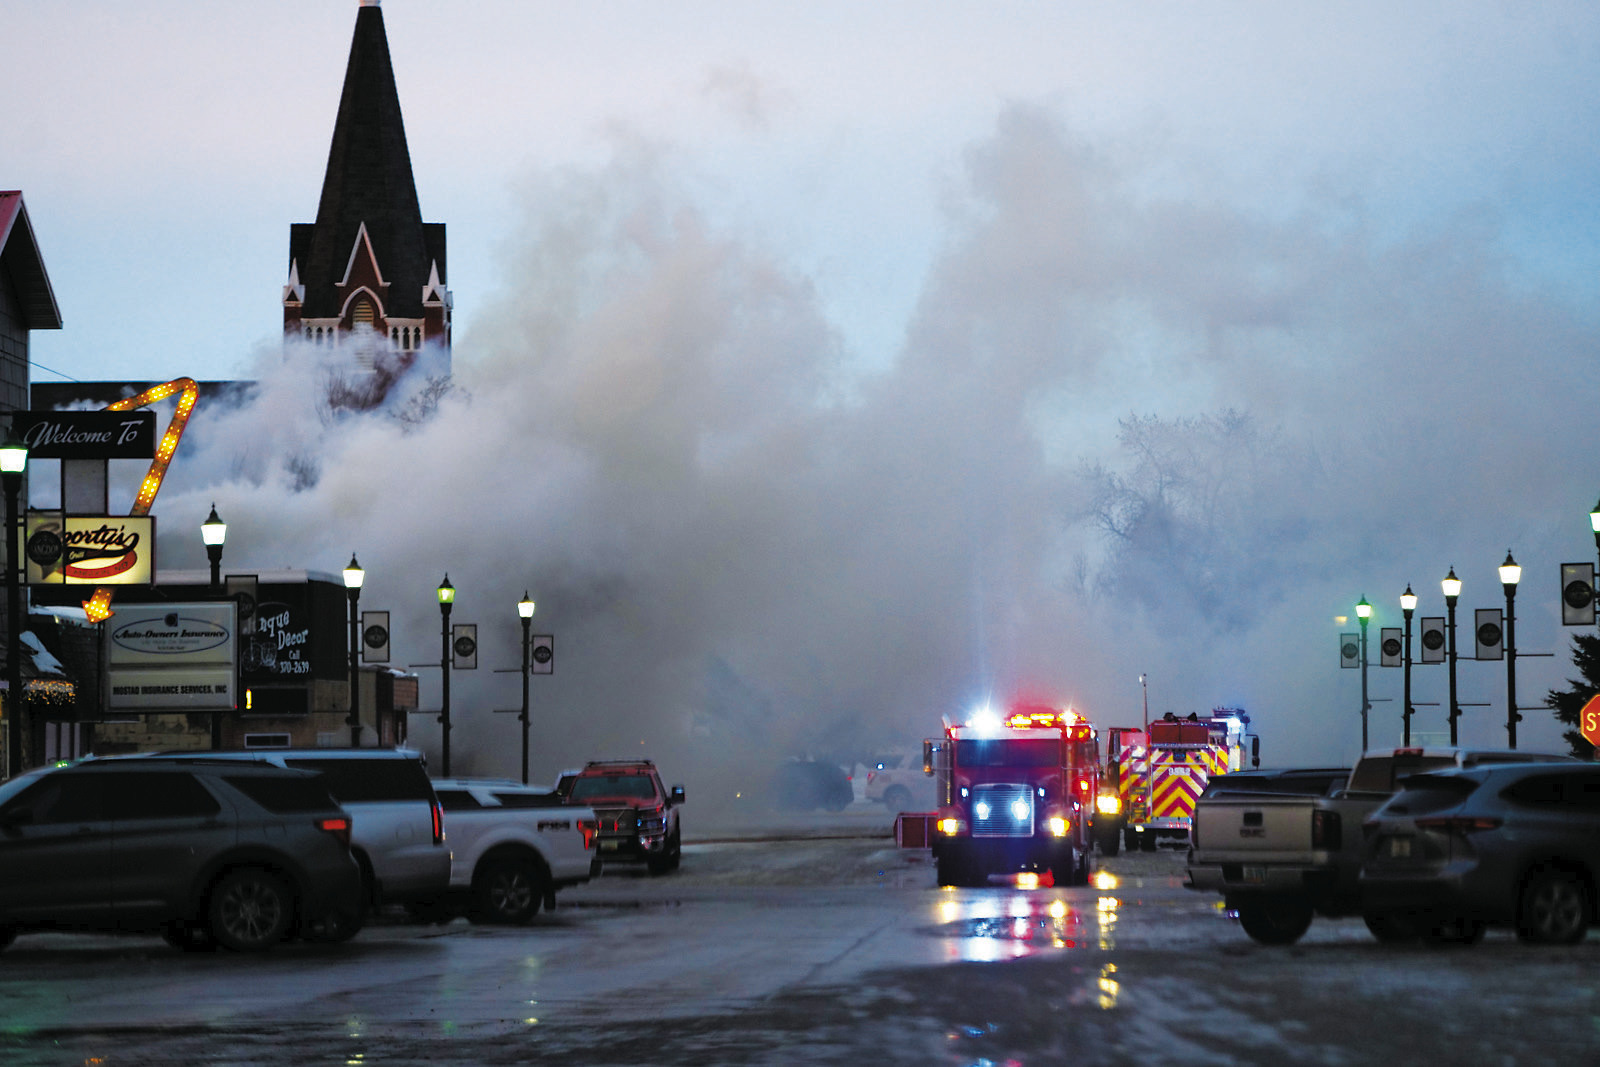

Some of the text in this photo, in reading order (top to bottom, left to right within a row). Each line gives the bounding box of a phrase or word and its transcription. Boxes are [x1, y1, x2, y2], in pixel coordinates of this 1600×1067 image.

[24, 420, 144, 449] Welcome To
[64, 524, 139, 551] porty's
[115, 629, 225, 639] Auto-Owners Insurance
[277, 629, 309, 650] Decor
[141, 685, 179, 695] INSURANCE
[180, 684, 214, 695] SERVICES,
[215, 684, 227, 694] INC
[1586, 712, 1600, 732] S
